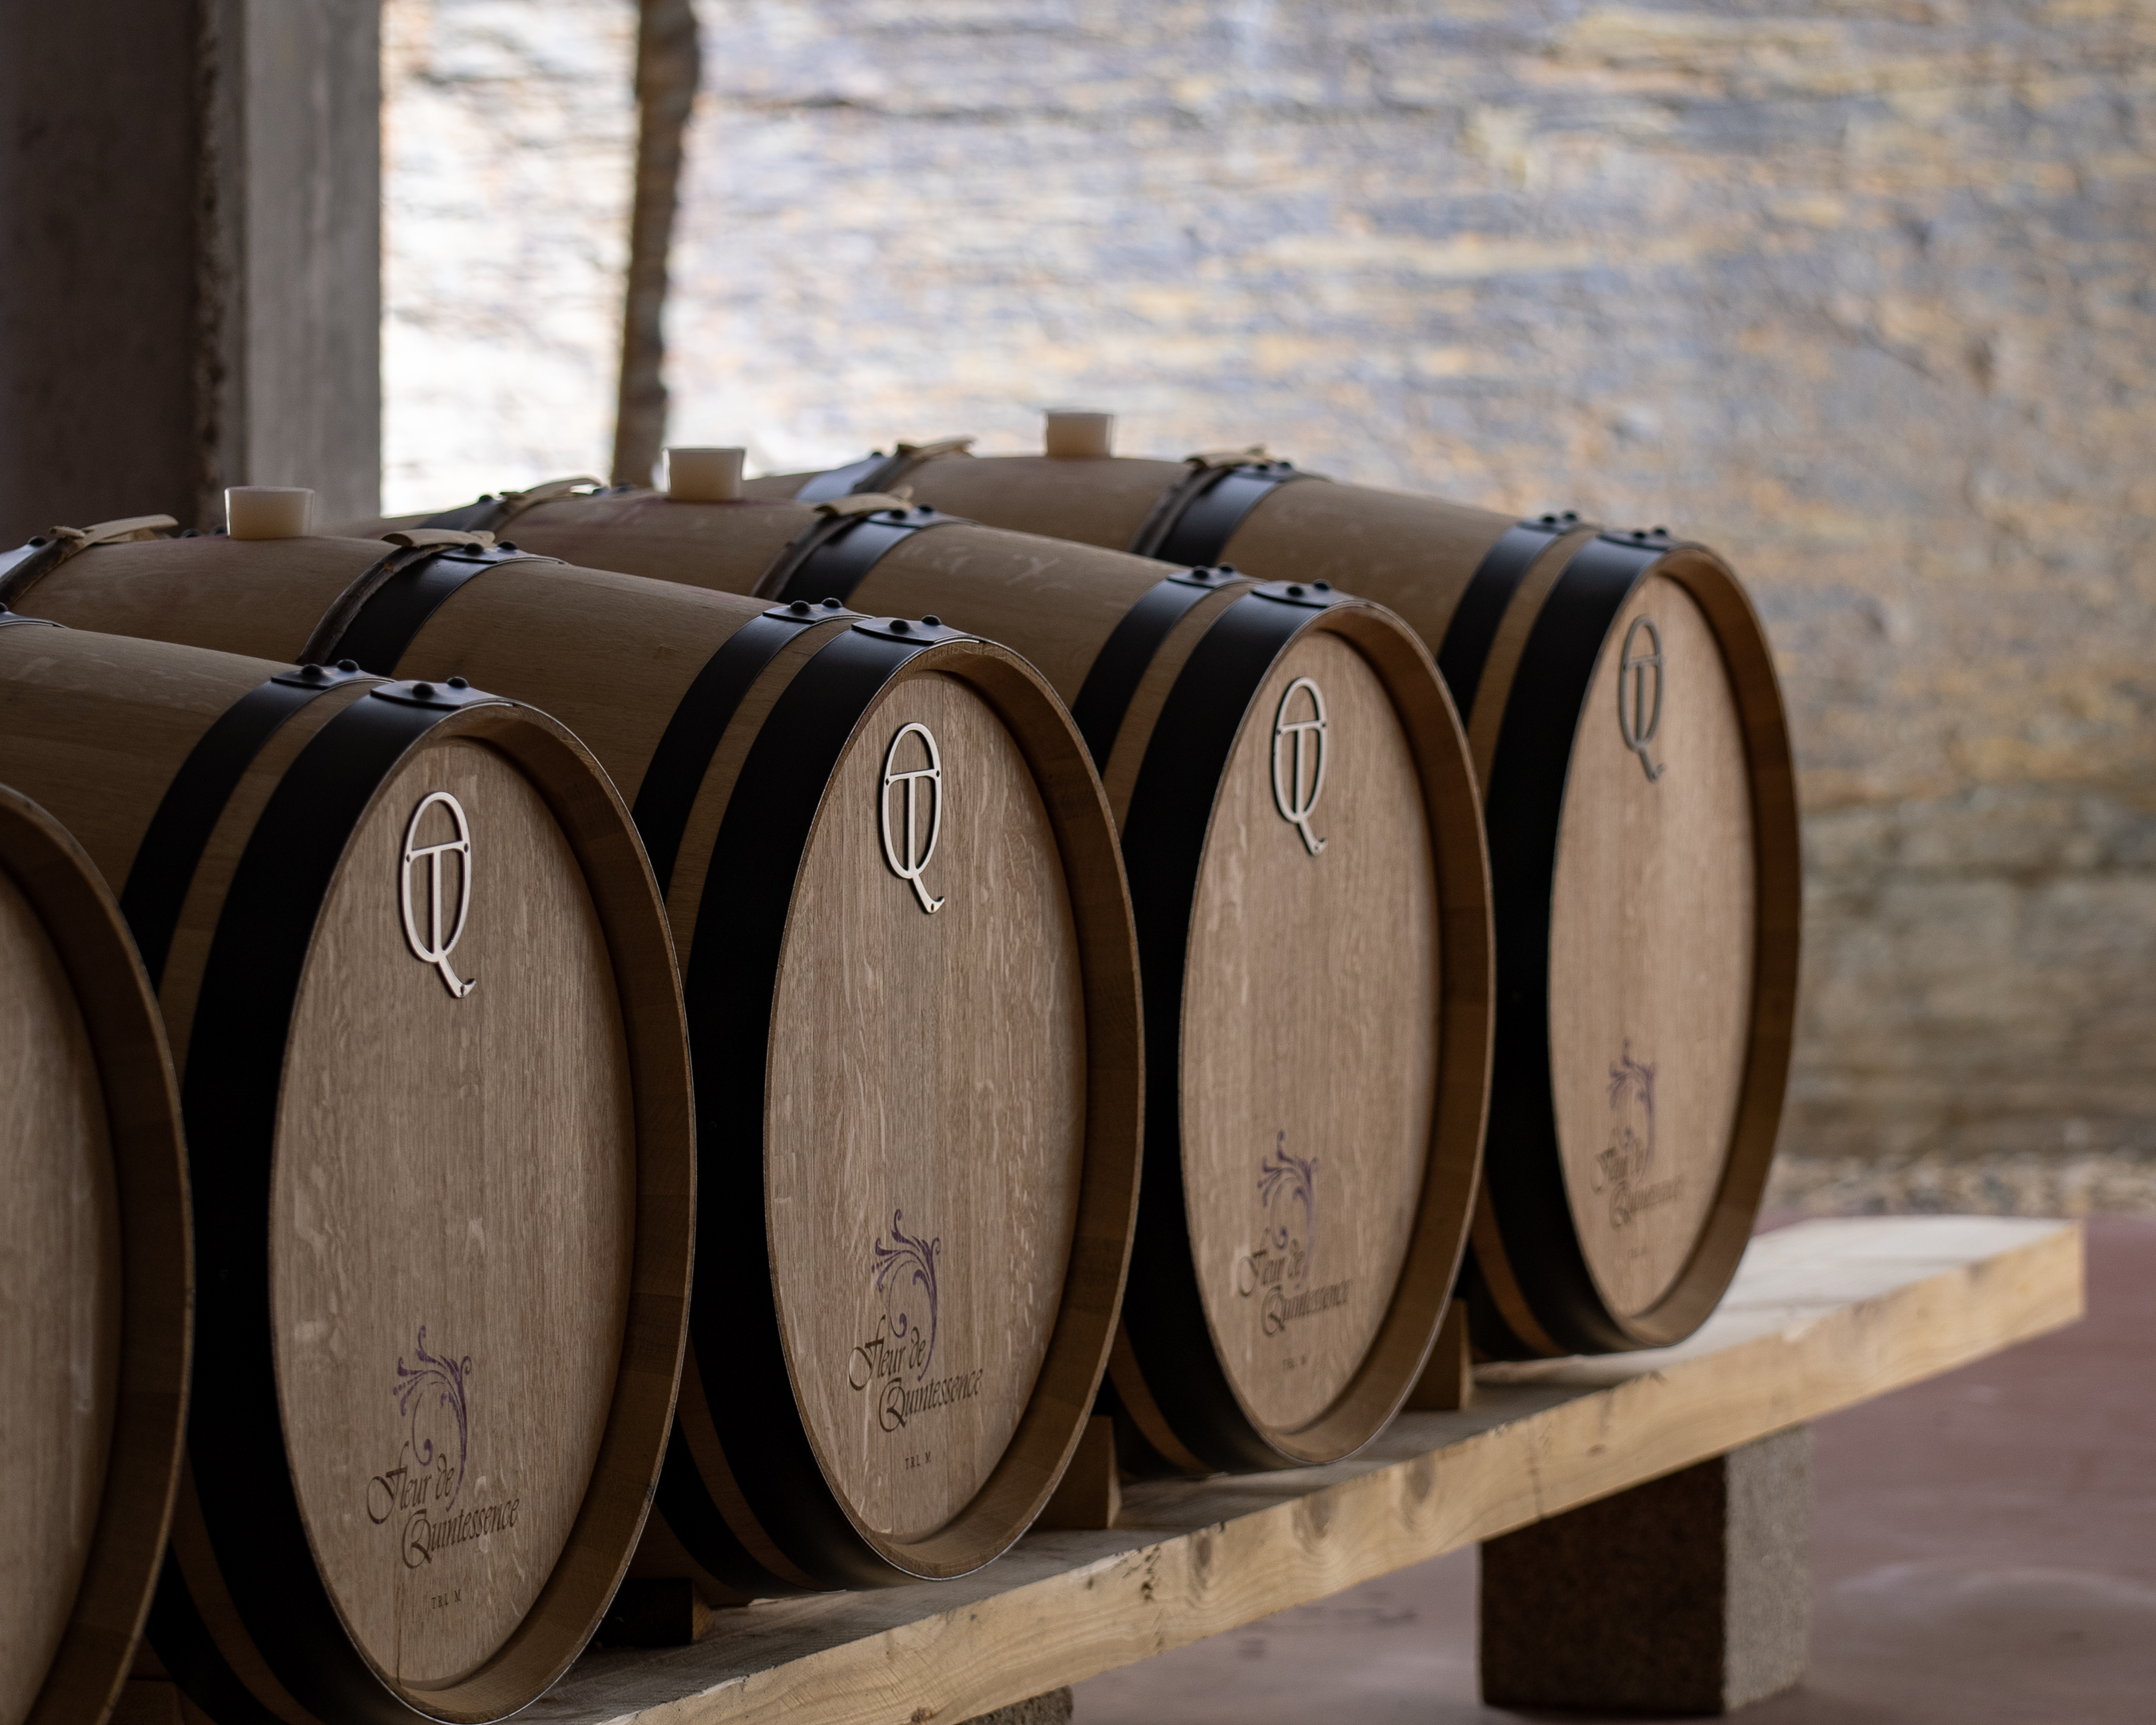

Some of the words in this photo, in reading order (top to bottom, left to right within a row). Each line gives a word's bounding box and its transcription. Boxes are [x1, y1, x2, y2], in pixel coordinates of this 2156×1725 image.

[848, 1315, 906, 1391] Fleur
[910, 1326, 926, 1367] de
[878, 1368, 984, 1433] Quintessence
[367, 1440, 433, 1525] Fleur
[435, 1453, 455, 1500] de
[402, 1498, 520, 1569] Quintessence
